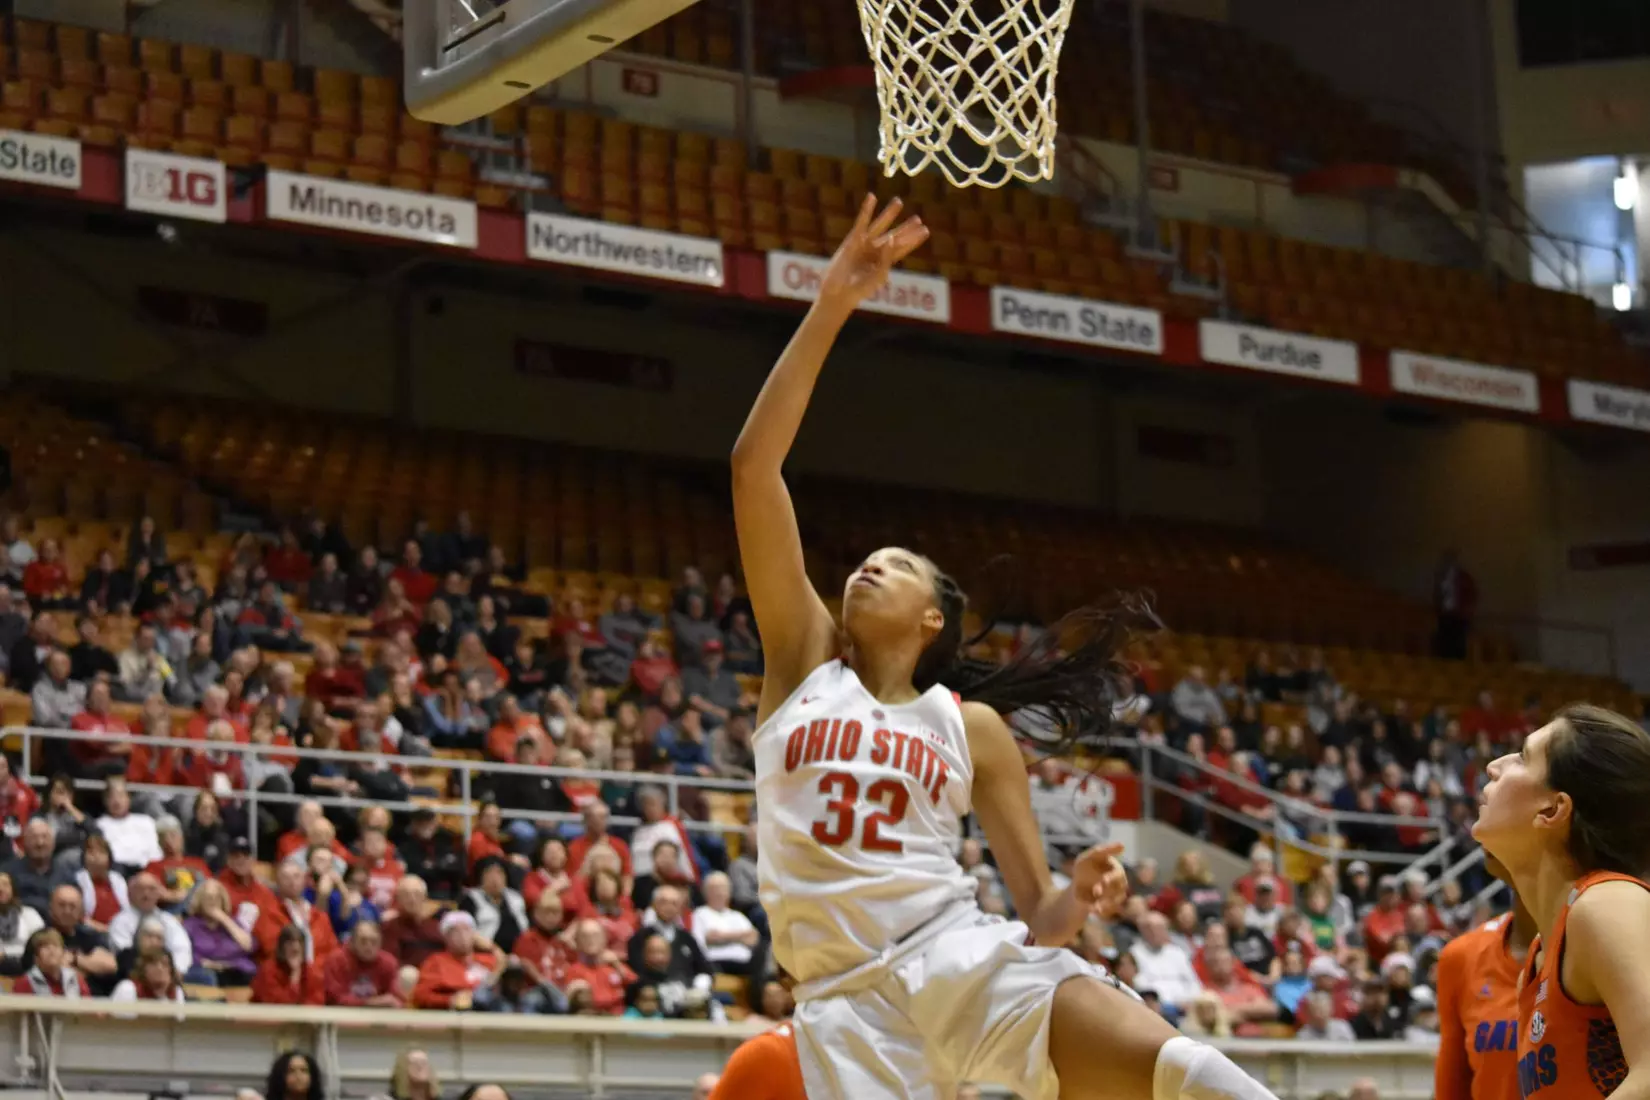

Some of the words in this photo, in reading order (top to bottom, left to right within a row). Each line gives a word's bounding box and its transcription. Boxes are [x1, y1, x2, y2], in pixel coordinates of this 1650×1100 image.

[0, 139, 76, 178] State
[289, 184, 457, 234] Minnesota
[533, 223, 719, 278] Northwestern
[1001, 296, 1070, 333] Penn
[1079, 307, 1155, 347] State
[1238, 332, 1322, 371] Purdue
[1409, 360, 1526, 399] Wisconsin
[784, 718, 864, 775] OHIO
[869, 727, 951, 805] STATE
[811, 770, 909, 854] 32
